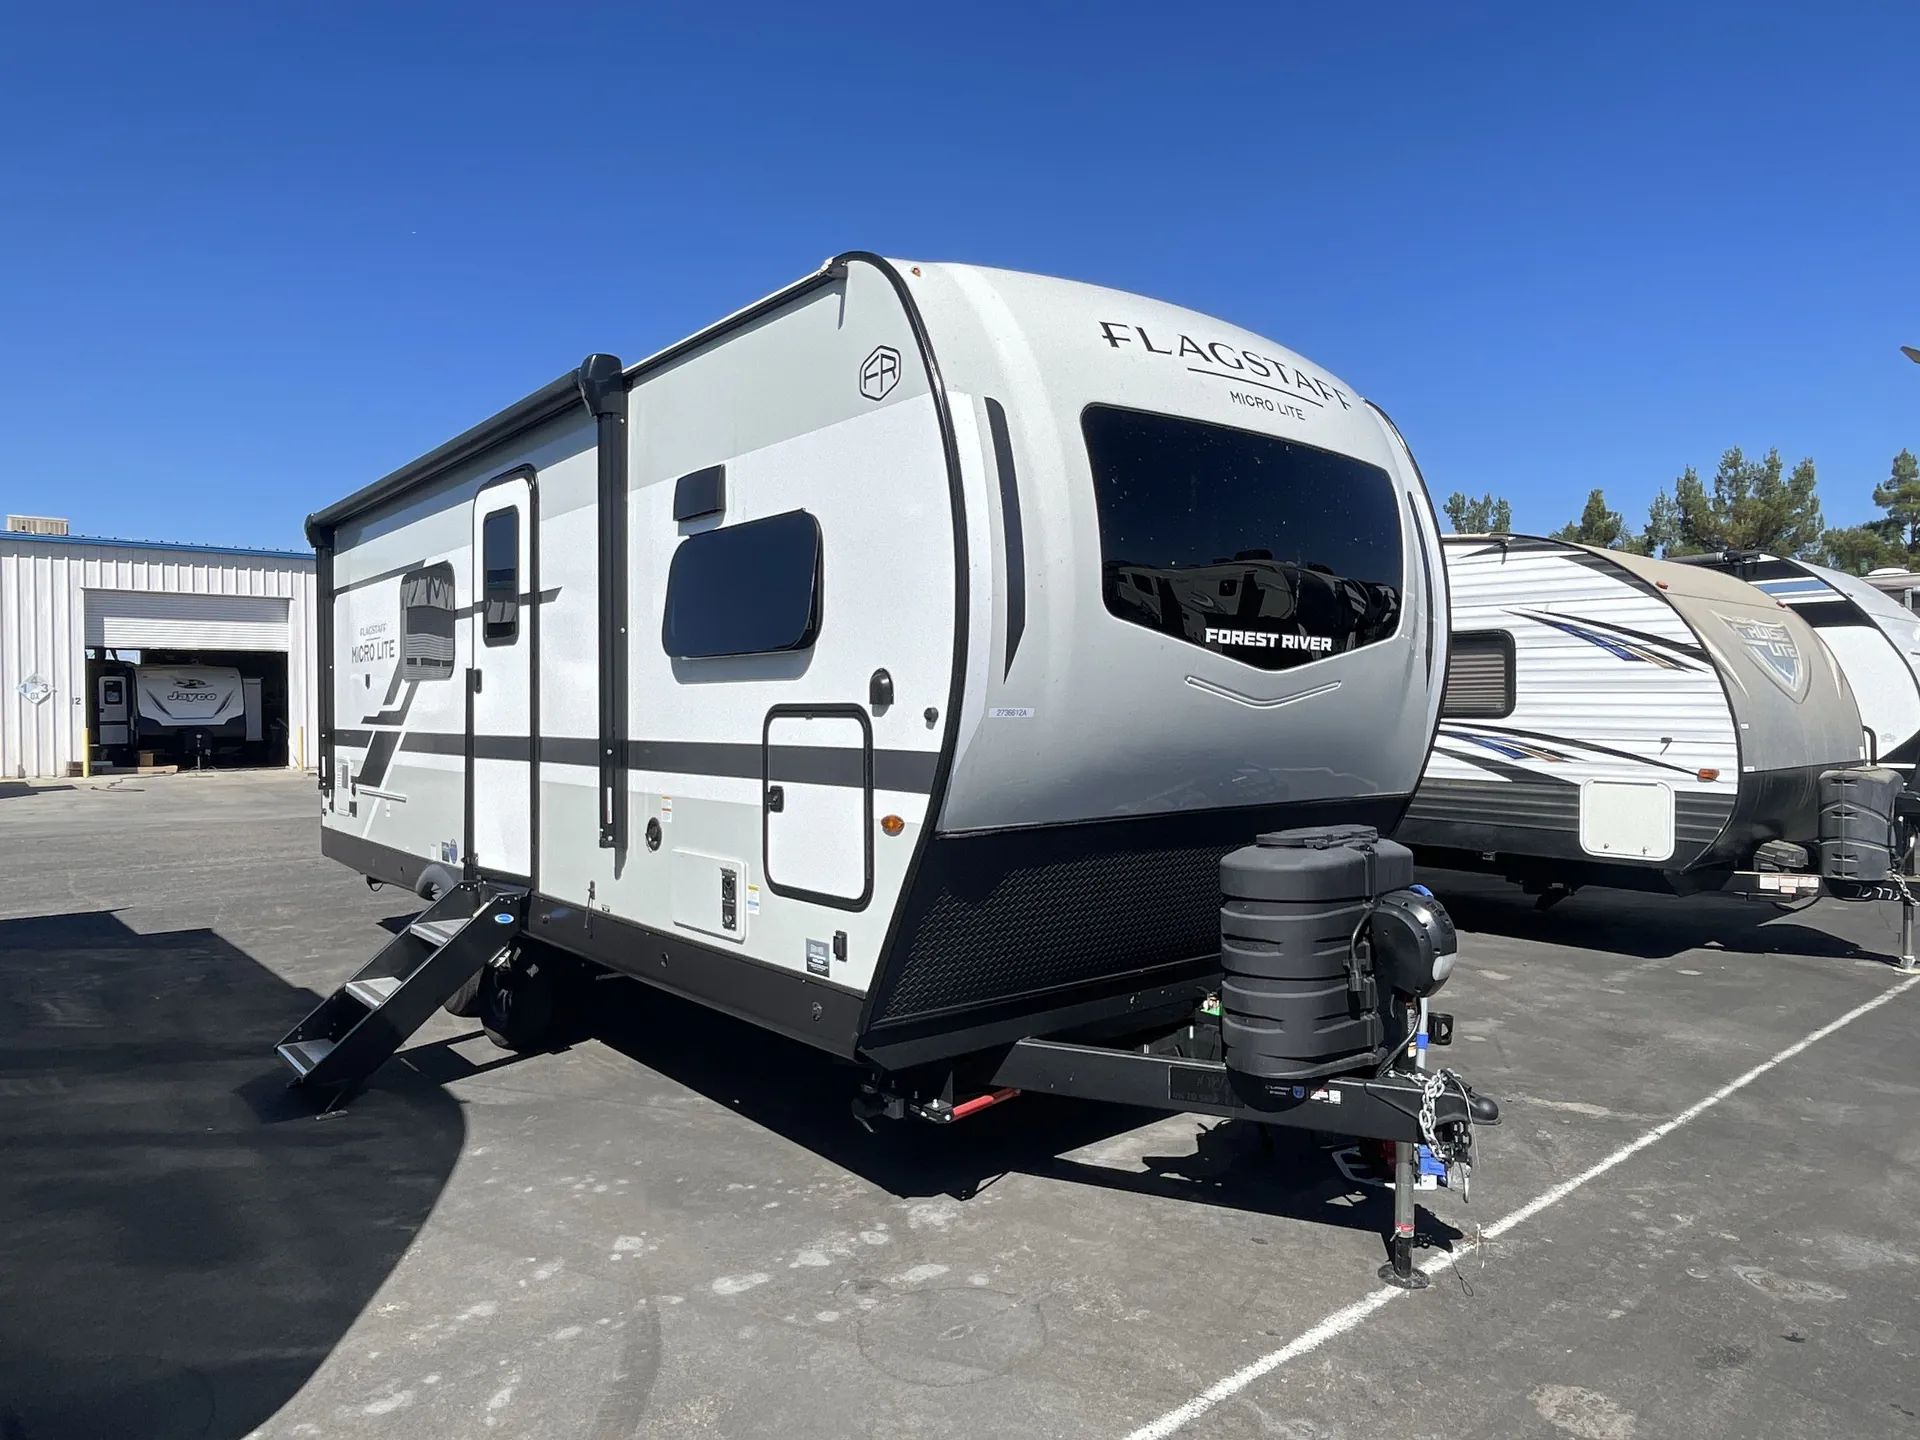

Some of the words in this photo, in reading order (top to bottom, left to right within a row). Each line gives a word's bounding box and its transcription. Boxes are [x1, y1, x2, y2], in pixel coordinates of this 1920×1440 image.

[1099, 321, 1352, 410] FLAGSTAFF
[1230, 391, 1274, 412] MICRO
[1277, 404, 1306, 421] LITE
[1205, 627, 1279, 648] FOREST
[1281, 634, 1332, 651] RIVER
[351, 643, 375, 664] MICRO
[377, 639, 395, 660] LITE
[41, 683, 49, 693] 3
[167, 691, 217, 702] Jayco
